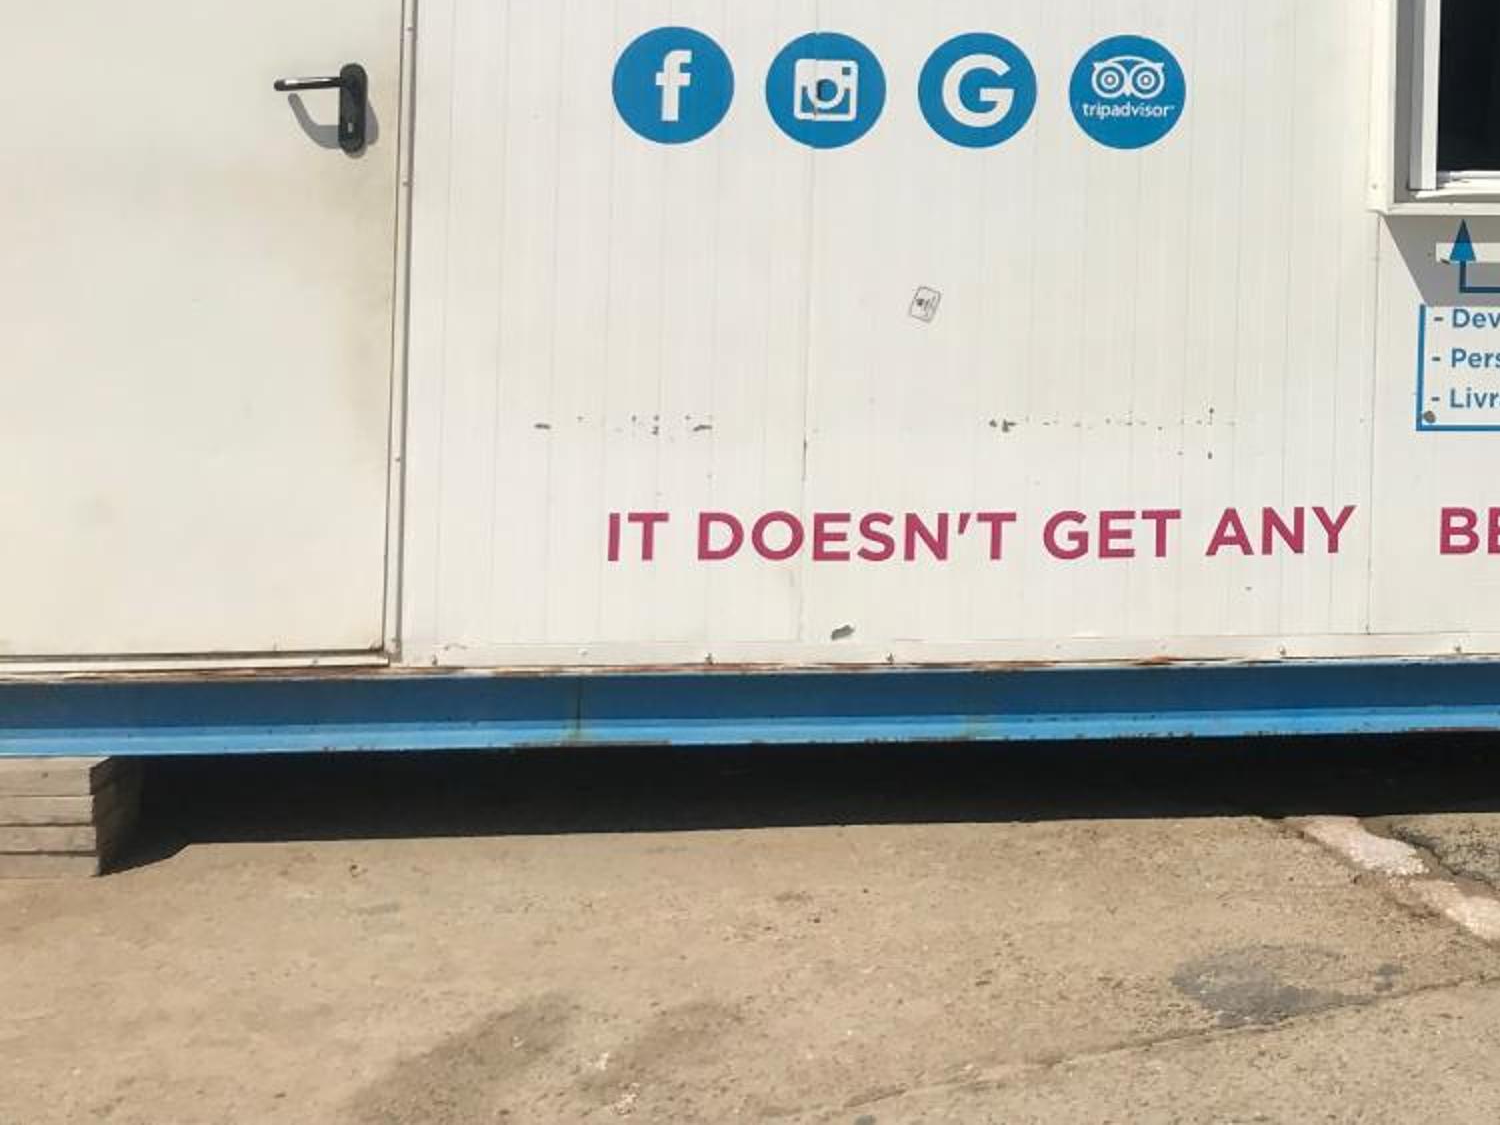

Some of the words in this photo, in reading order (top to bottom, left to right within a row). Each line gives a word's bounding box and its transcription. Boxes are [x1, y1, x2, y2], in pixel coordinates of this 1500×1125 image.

[1082, 100, 1170, 121] tripadvisor
[608, 513, 669, 561] IT
[698, 511, 1016, 561] DOESN'T
[1043, 509, 1181, 560] GET
[1206, 505, 1355, 556] ANY
